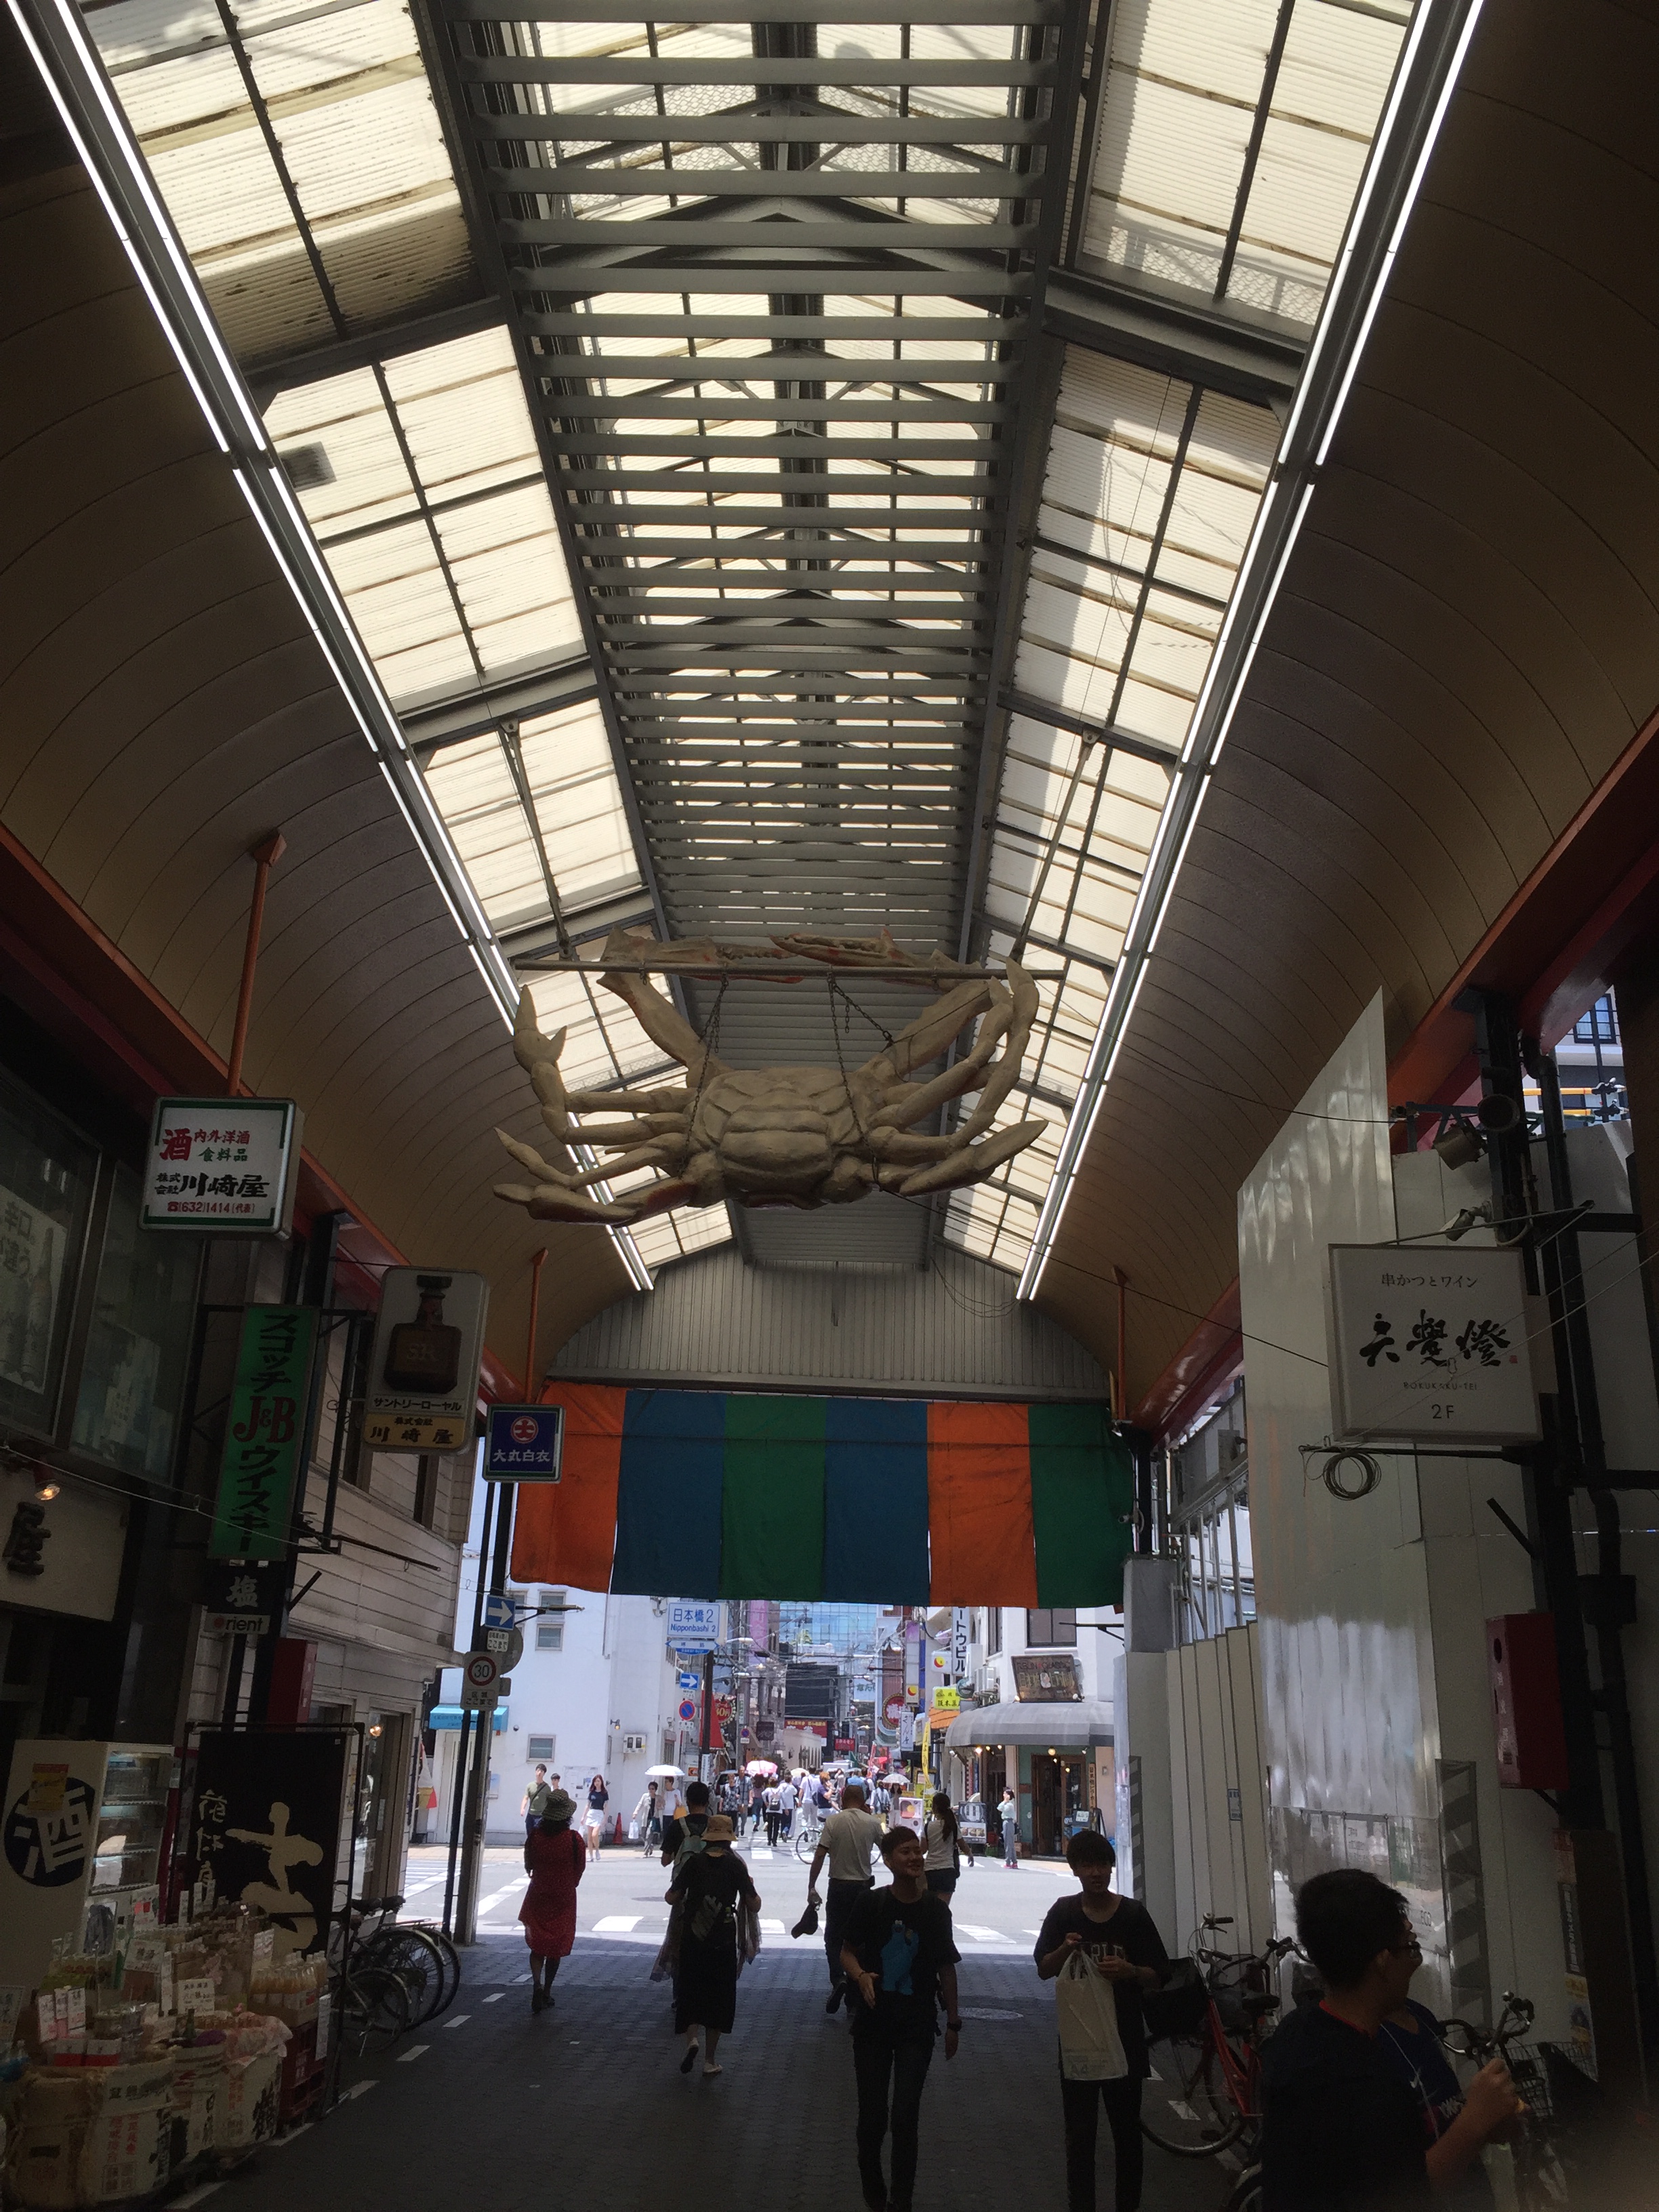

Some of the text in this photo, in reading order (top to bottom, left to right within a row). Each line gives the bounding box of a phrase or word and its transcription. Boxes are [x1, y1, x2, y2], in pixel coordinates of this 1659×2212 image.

[159, 1128, 192, 1161] 酒
[194, 1128, 250, 1145] 内外洋酒
[198, 1147, 248, 1162] 食料品
[1381, 1273, 1478, 1288] 串かつとワイン
[250, 1313, 300, 1393] スコッチ
[373, 1398, 462, 1412] サントリーローヤル
[1431, 1404, 1455, 1420] 2F
[232, 1395, 296, 1443] J&B
[492, 1448, 552, 1464] 大丸白衣
[226, 1574, 258, 1607] 塩
[670, 1623, 716, 1633] Nipponbashi 2
[955, 1606, 967, 1673] ートウビル
[474, 1664, 490, 1678] 30
[12, 1785, 91, 1880] 酒
